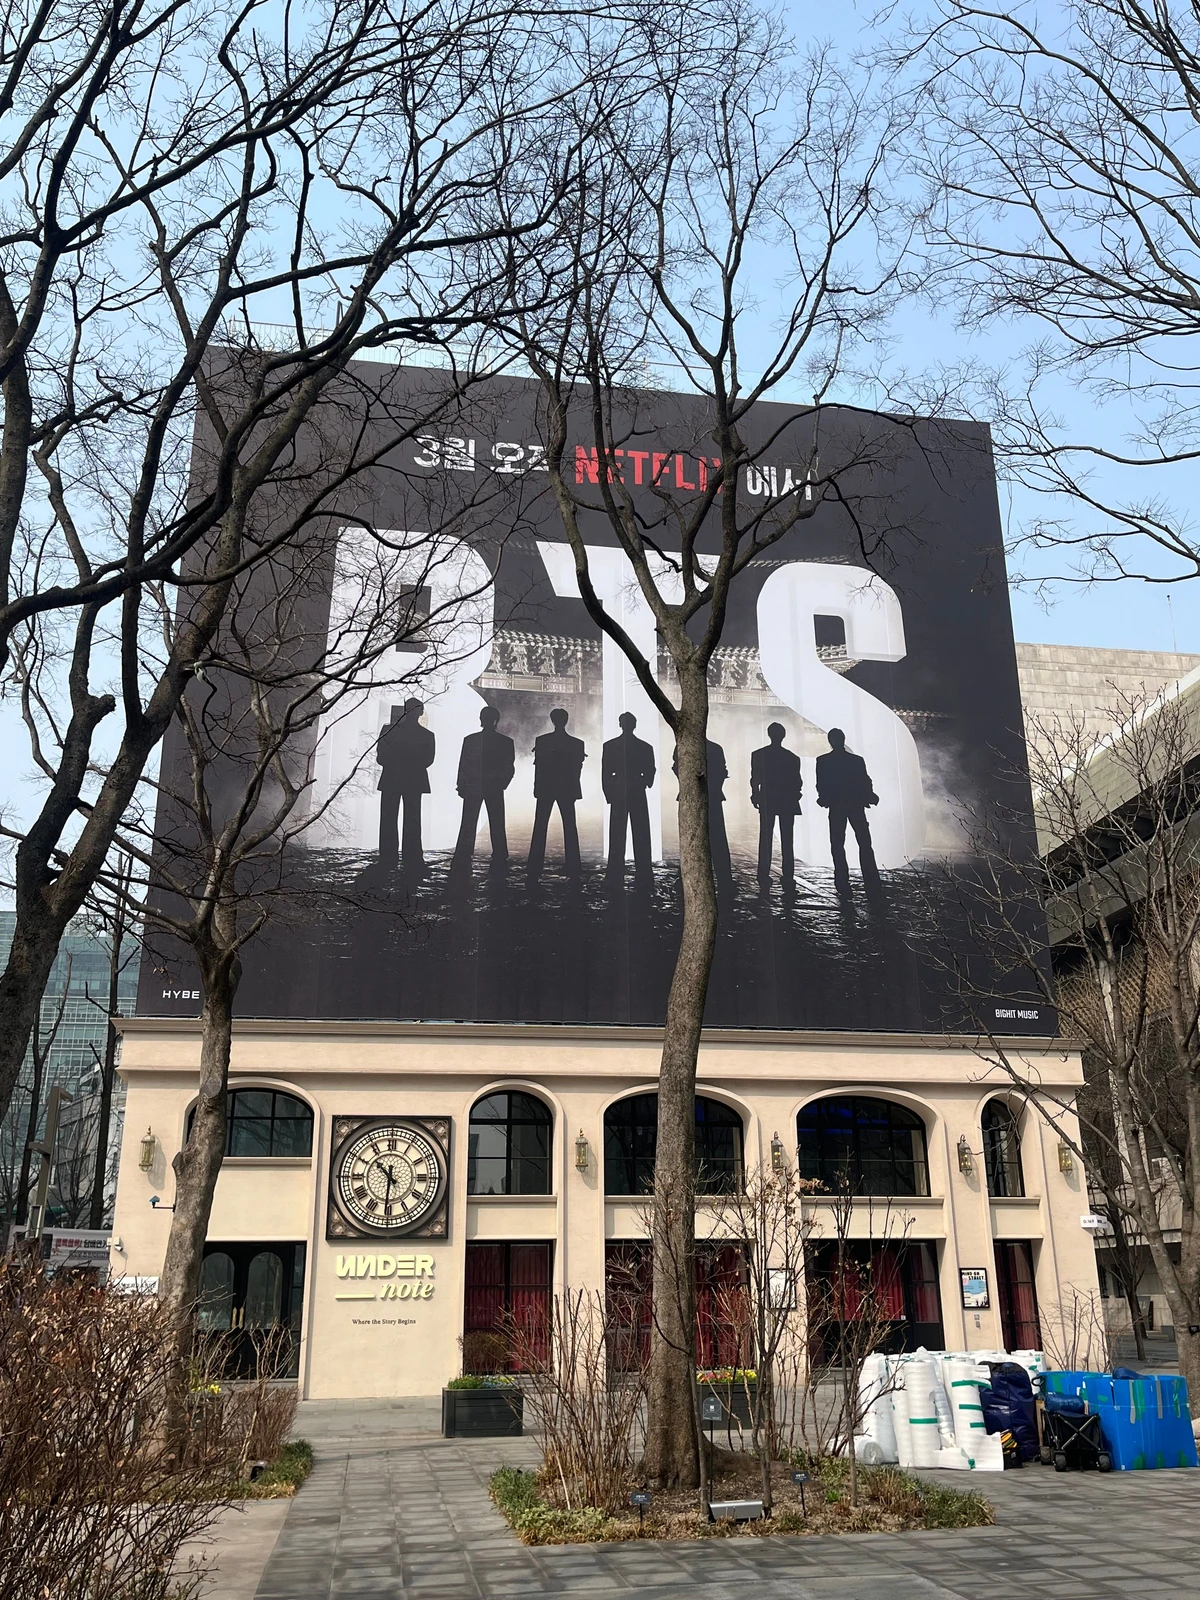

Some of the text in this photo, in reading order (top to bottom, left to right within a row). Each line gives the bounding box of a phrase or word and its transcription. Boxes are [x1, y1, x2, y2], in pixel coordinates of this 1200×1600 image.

[413, 434, 476, 472] 3월
[308, 527, 928, 870] BTS
[162, 989, 200, 1000] HYBE
[995, 1008, 1038, 1019] BIGHIT MUSIC
[336, 1254, 434, 1277] UNDER
[380, 1280, 434, 1298] note
